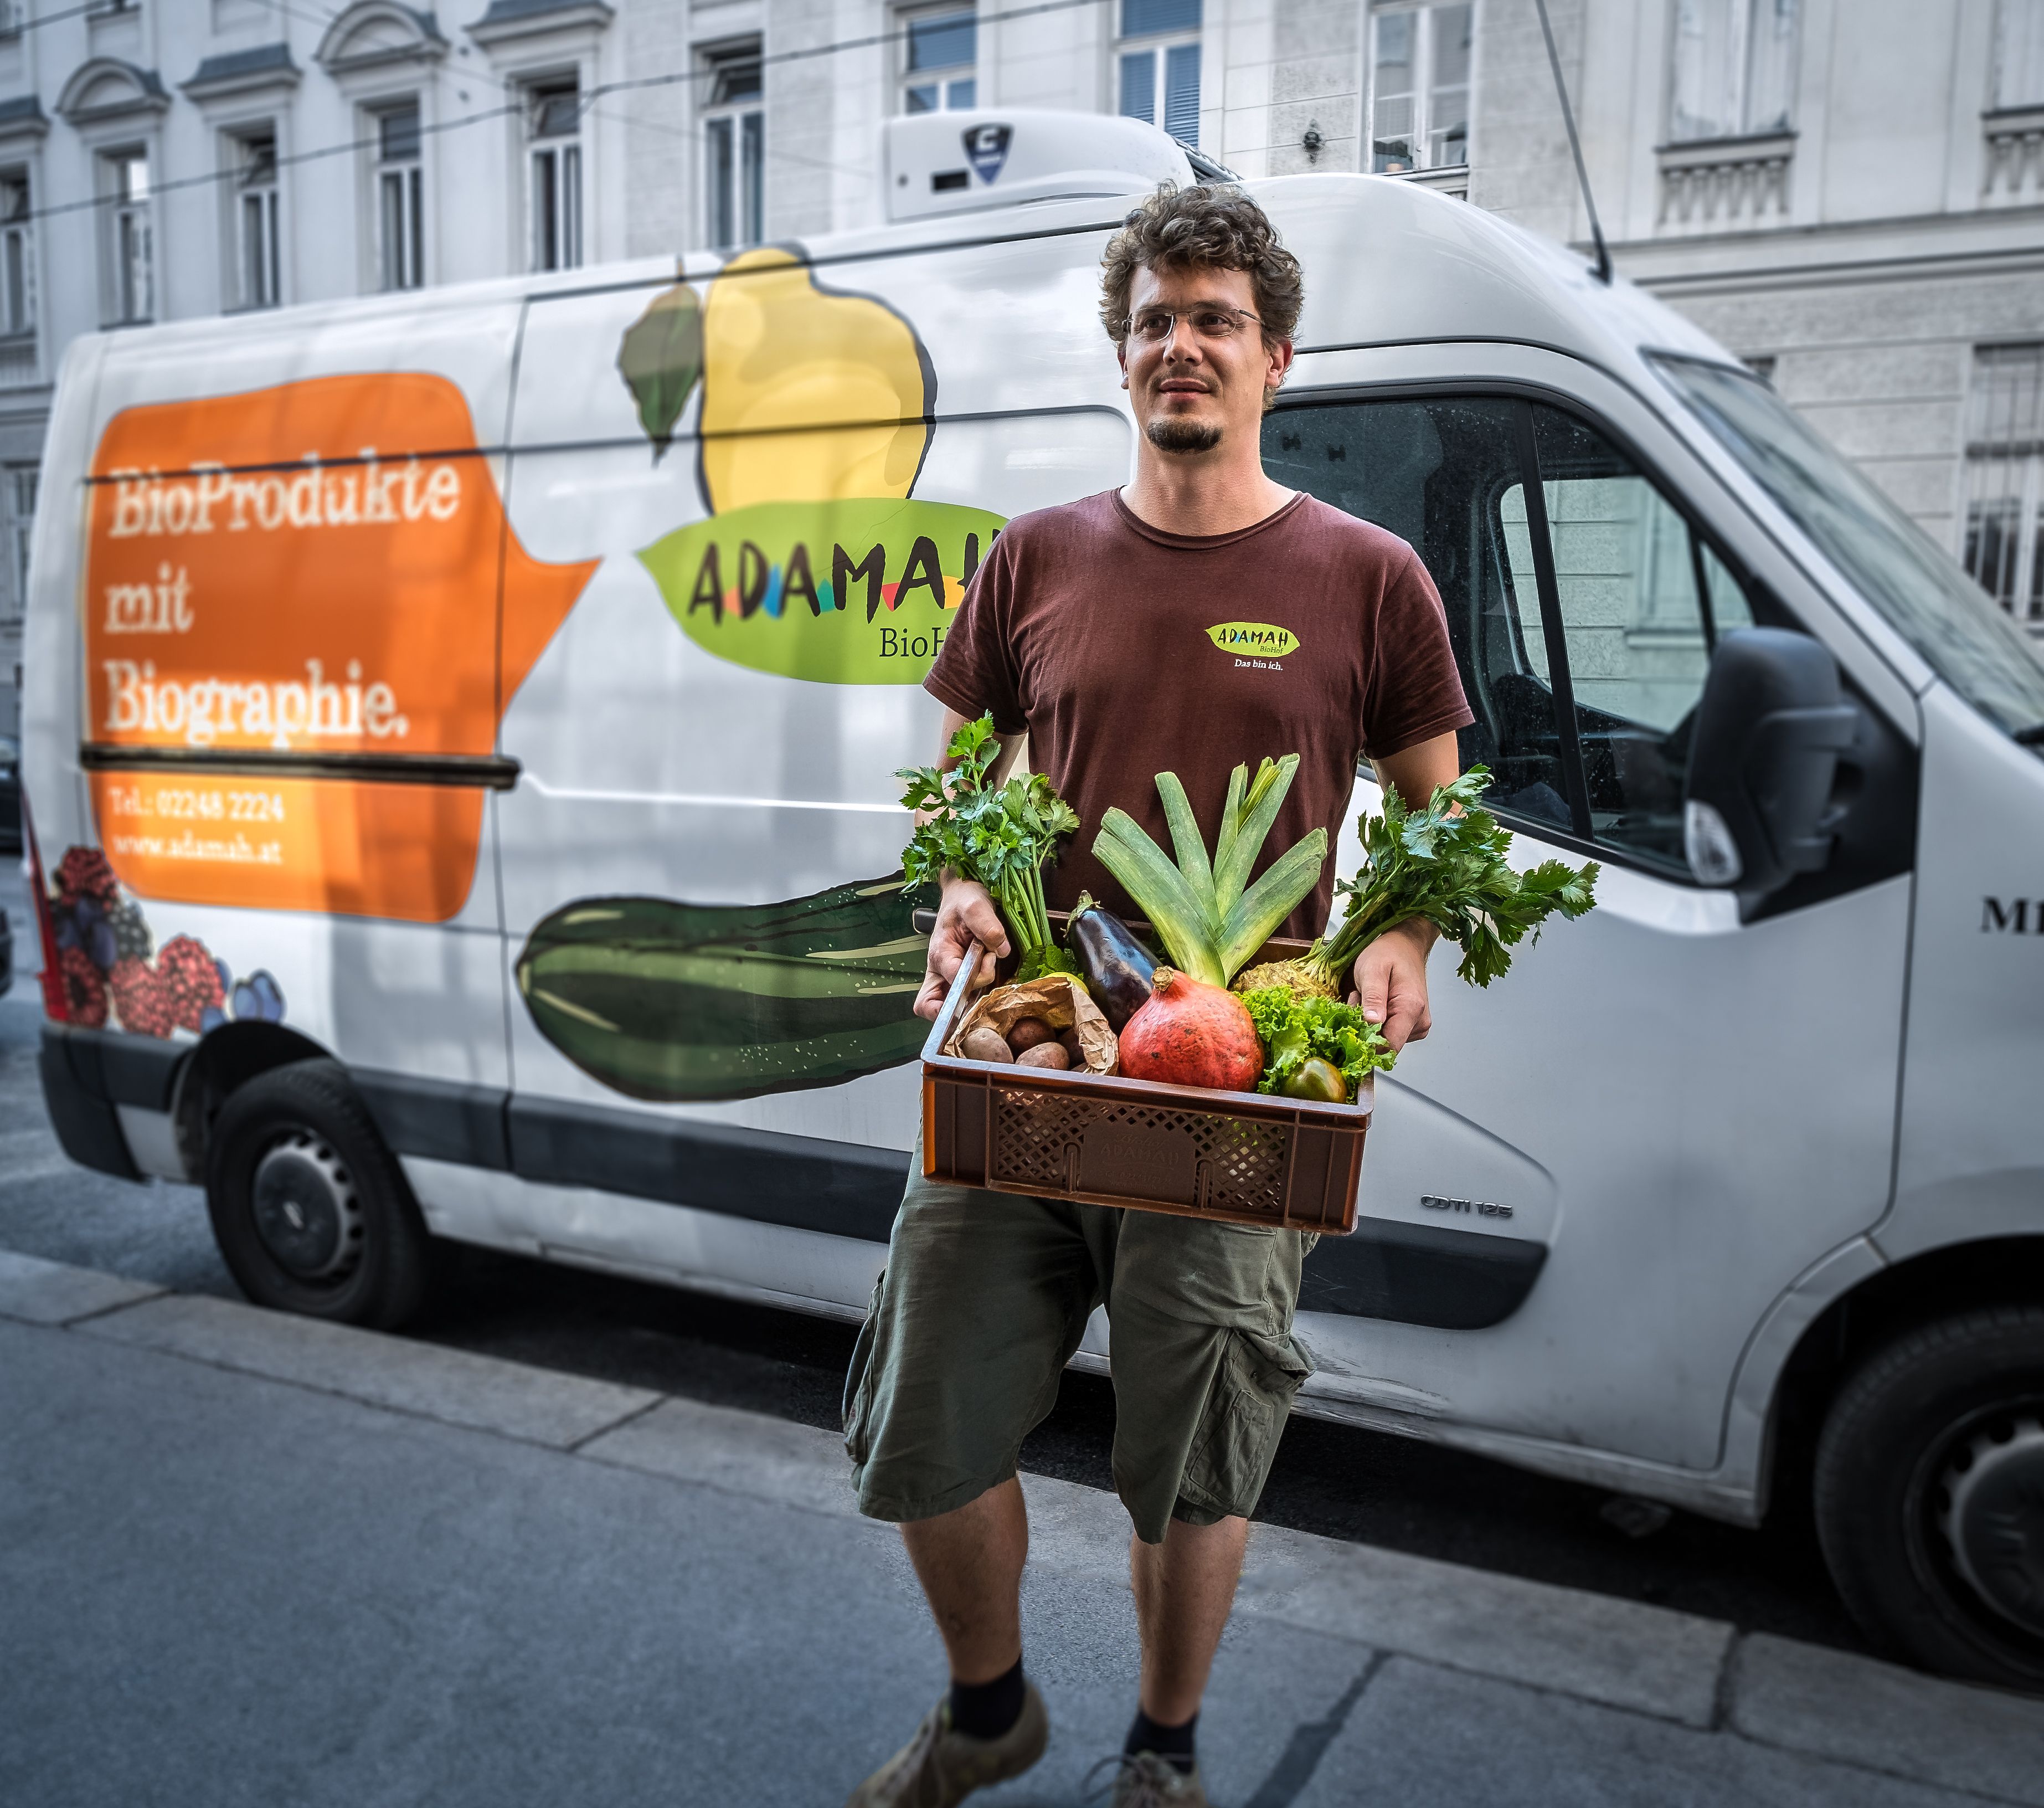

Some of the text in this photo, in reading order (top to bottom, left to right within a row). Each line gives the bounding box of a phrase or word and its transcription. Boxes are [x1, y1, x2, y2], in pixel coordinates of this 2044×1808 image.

[108, 446, 461, 538] BioProdukte
[103, 562, 194, 634] mit
[1217, 628, 1288, 648] ADAMAH
[1260, 645, 1284, 654] BioHof
[1234, 659, 1284, 671] Das bin ich.
[102, 659, 409, 752] Biographie.
[227, 791, 285, 822] 2224
[111, 828, 284, 865] www.adamah.at
[1420, 1194, 1513, 1218] CDTI 125
